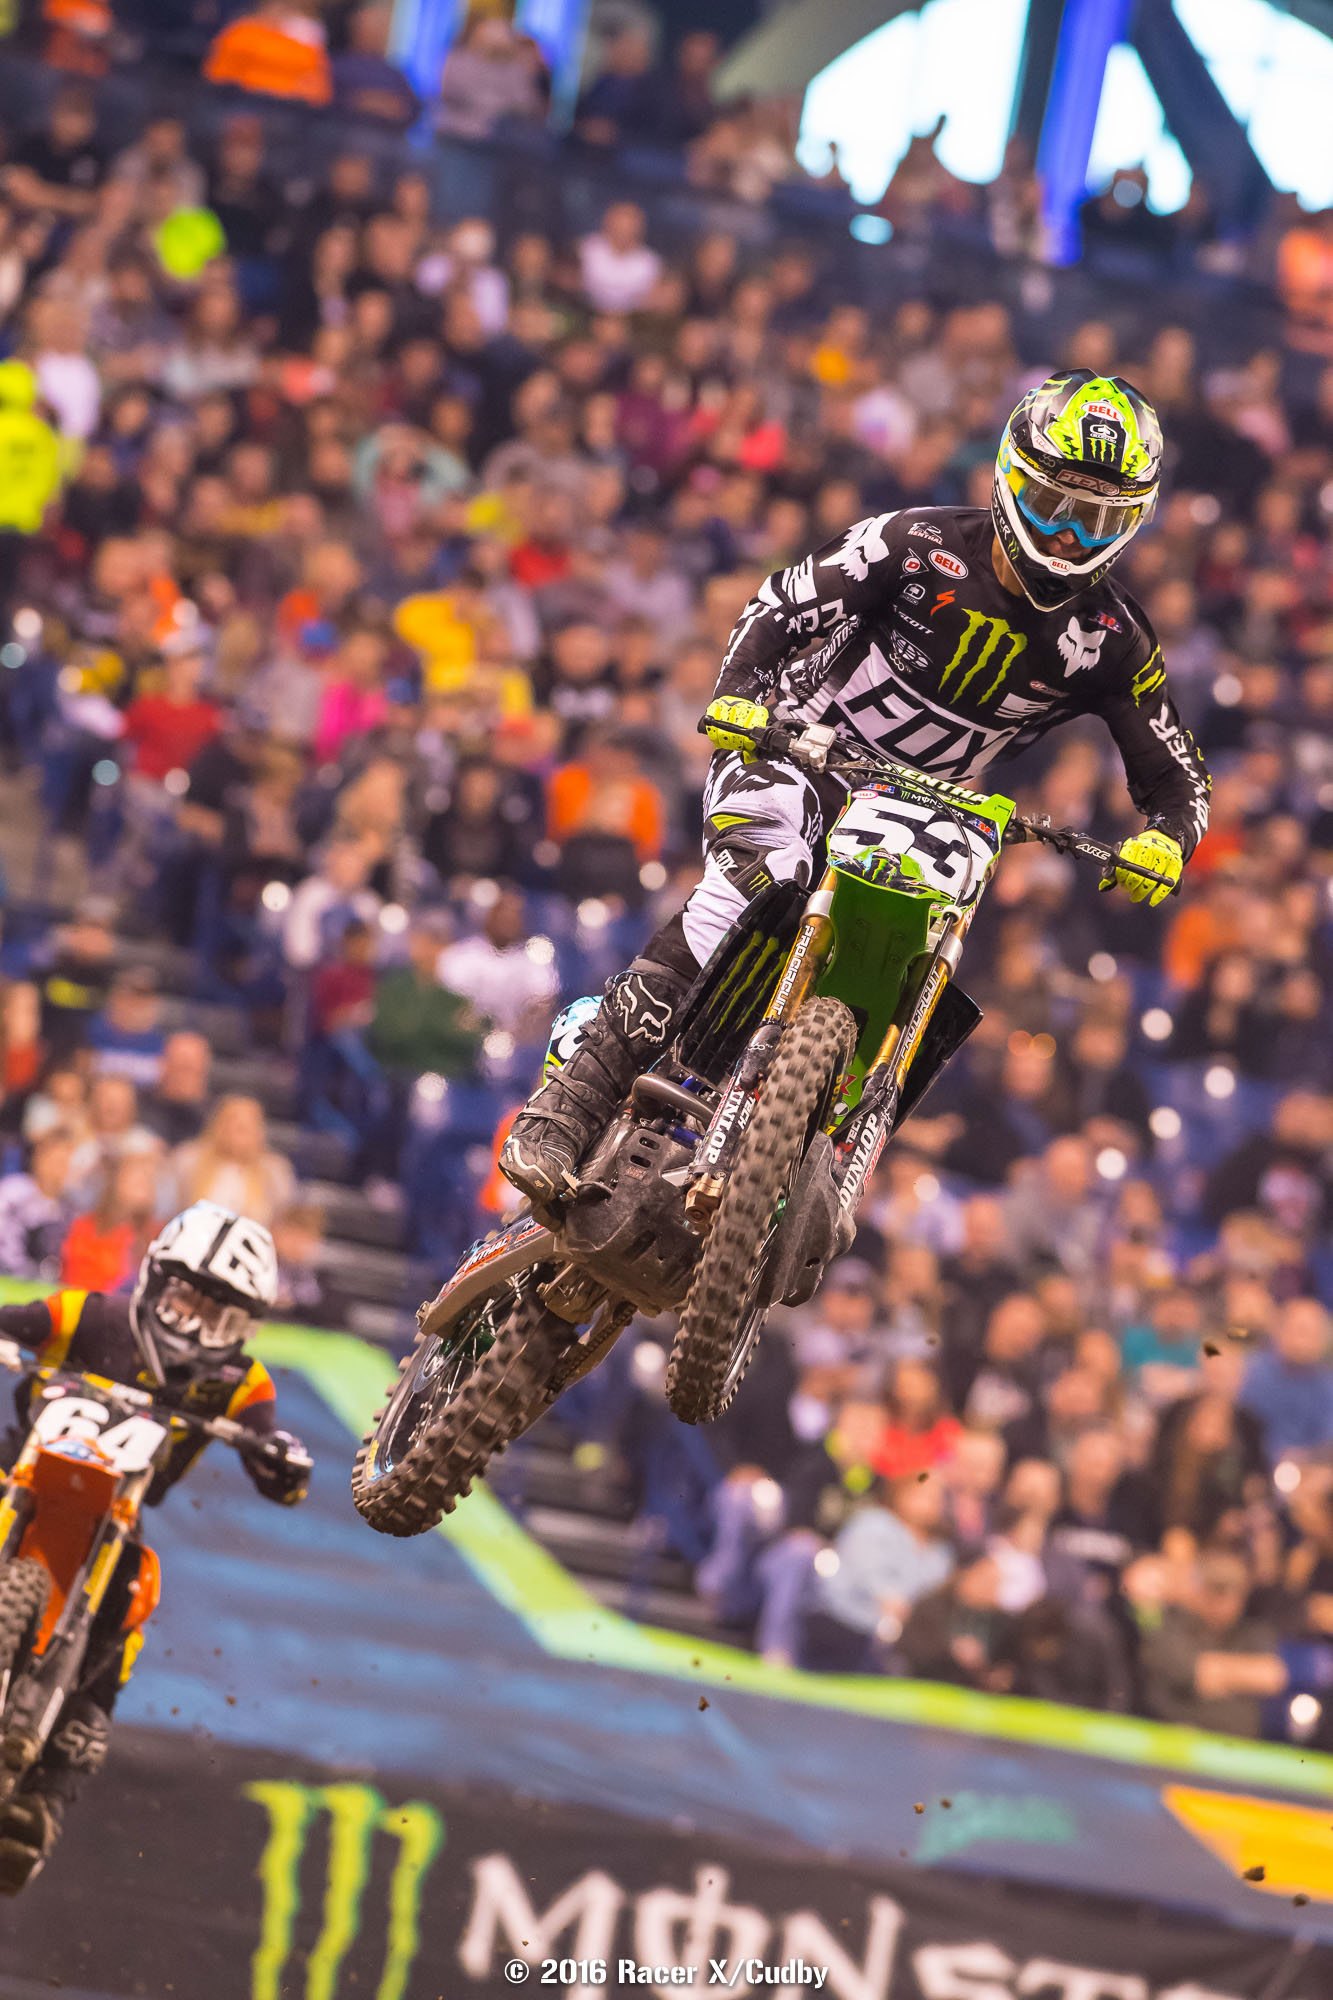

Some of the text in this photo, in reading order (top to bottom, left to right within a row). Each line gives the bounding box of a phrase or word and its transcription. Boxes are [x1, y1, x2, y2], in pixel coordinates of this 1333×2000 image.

[1088, 404, 1119, 421] BELL
[907, 530, 943, 546] RENTHAL
[934, 553, 961, 575] BELL
[1051, 561, 1069, 570] BELL
[844, 676, 1015, 778] FOX
[883, 763, 991, 803] RENTHA
[911, 794, 965, 820] MONSER
[716, 849, 739, 874] FOX
[829, 795, 995, 902] 53
[1075, 843, 1112, 861] ARC
[772, 925, 815, 1016] PRO CIRCUIT
[708, 1071, 745, 1165] UNLOP
[840, 1113, 879, 1211] DUNLOP
[35, 1397, 167, 1473] 64
